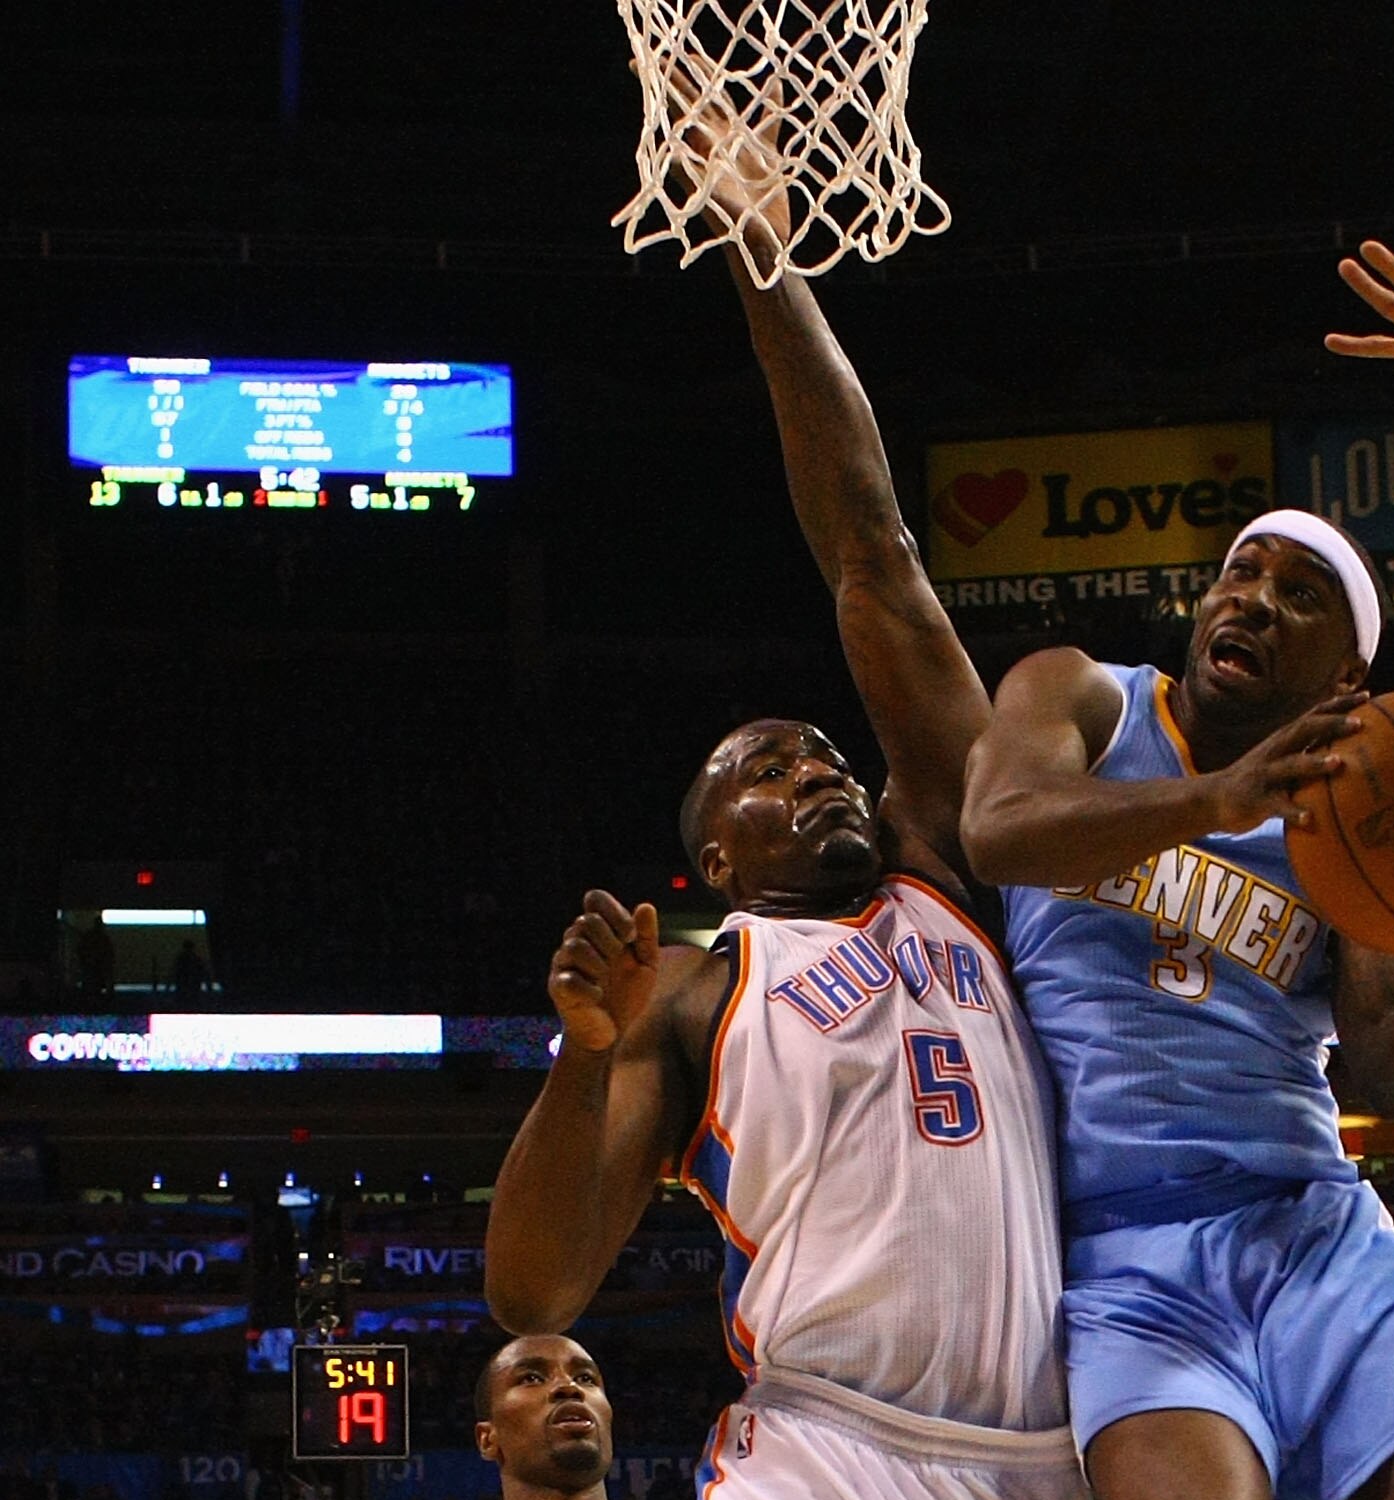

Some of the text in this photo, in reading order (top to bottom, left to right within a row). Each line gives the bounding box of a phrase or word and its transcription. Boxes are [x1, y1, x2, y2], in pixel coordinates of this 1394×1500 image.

[936, 577, 1057, 610] BRING
[1067, 567, 1151, 600] THE
[1150, 919, 1214, 1003] 3
[902, 1029, 984, 1146] 5
[53, 1248, 206, 1278] CASINO
[325, 1358, 395, 1389] 5:41
[337, 1391, 386, 1444] 19
[178, 1455, 241, 1483] 120
